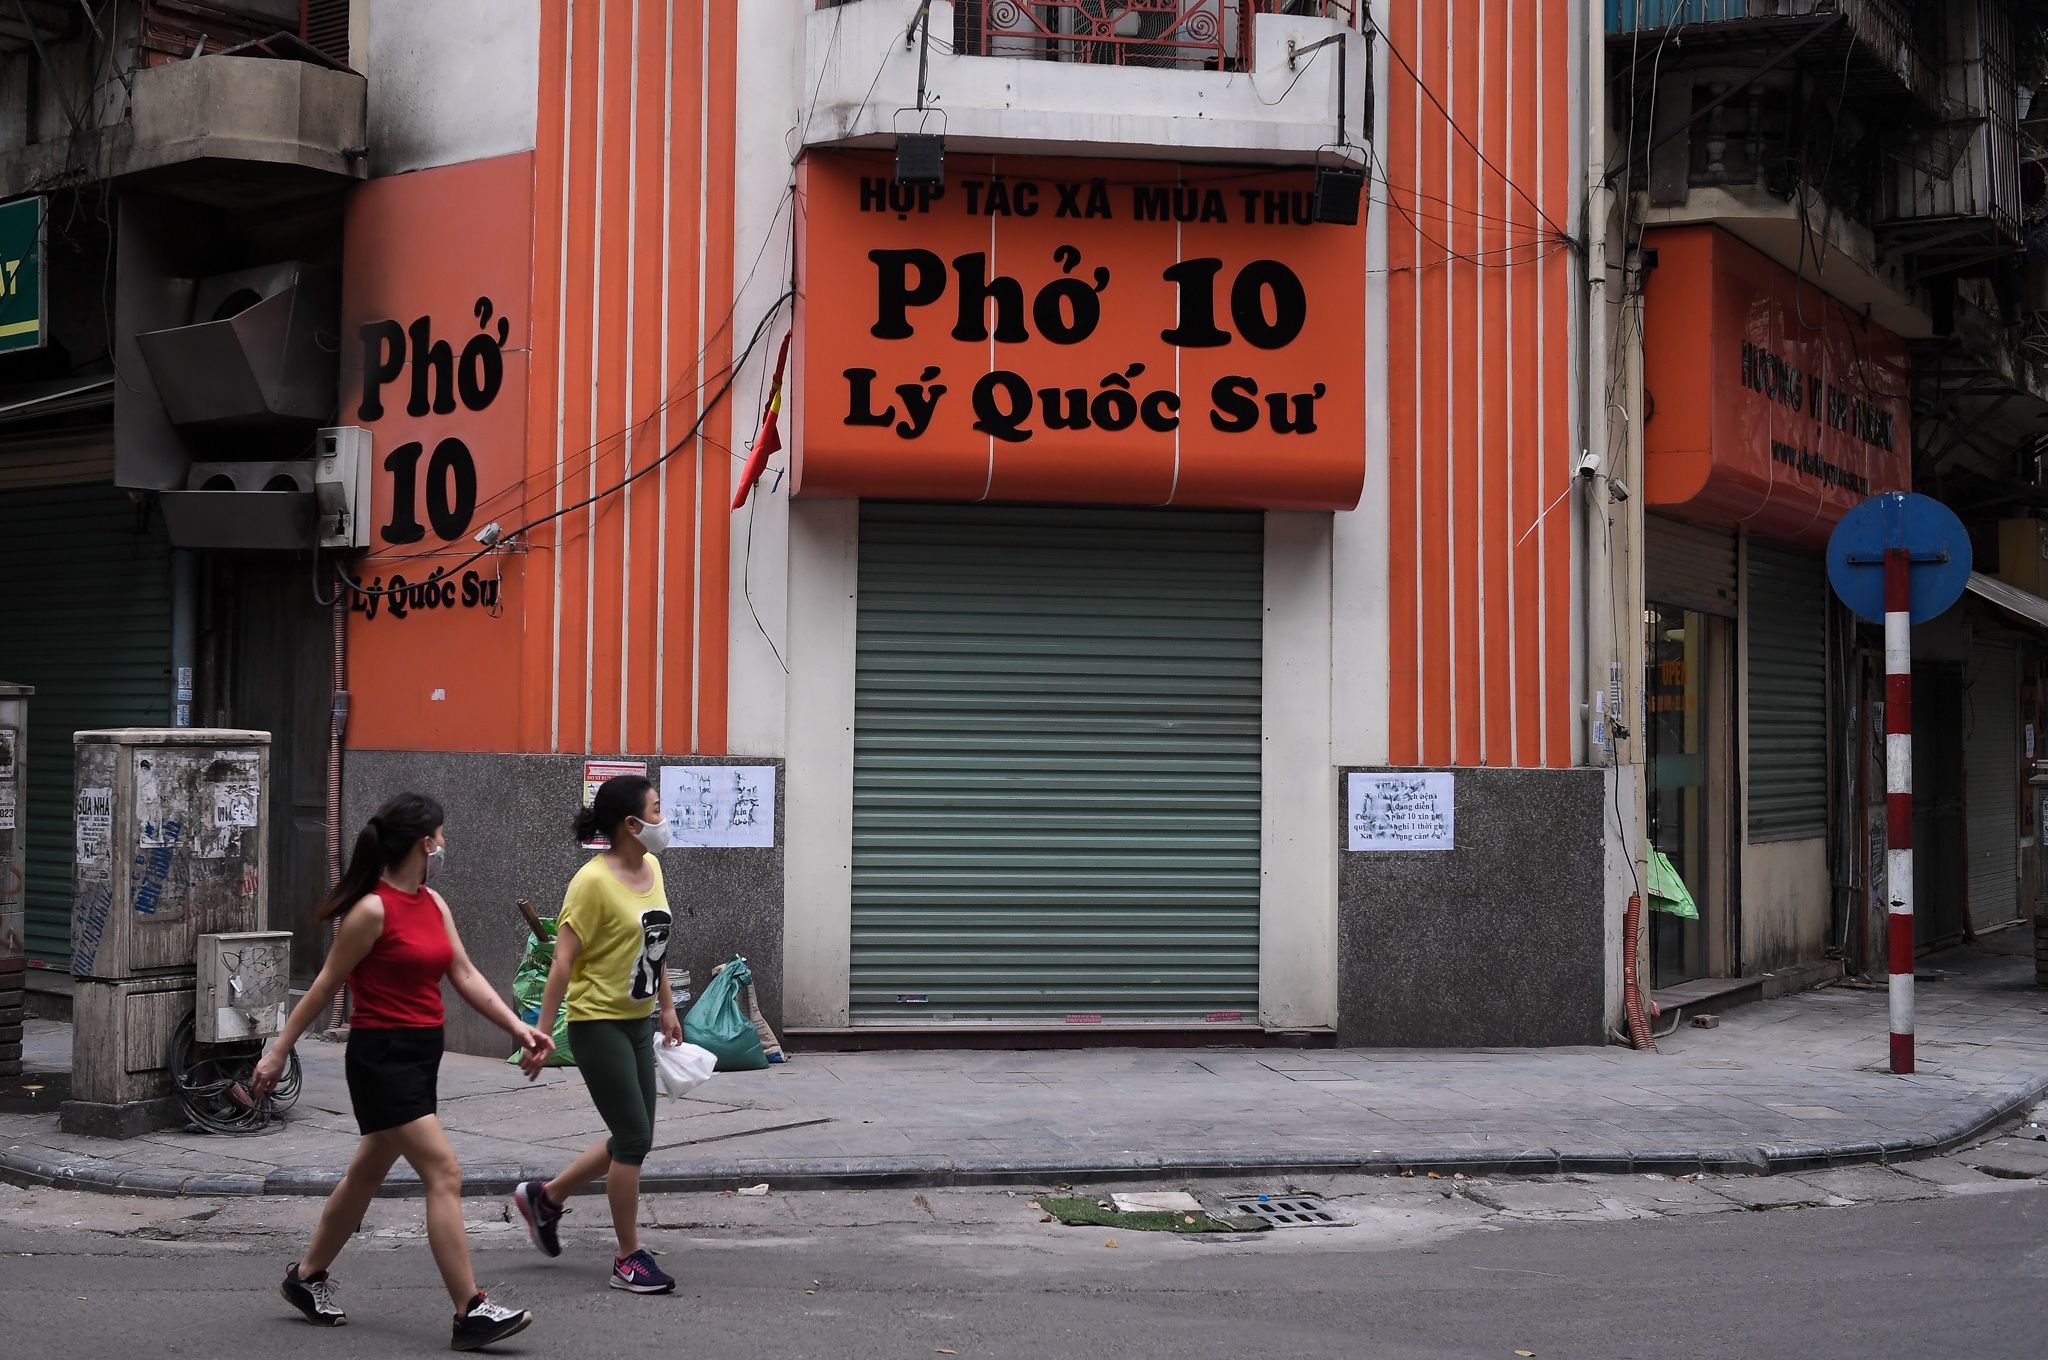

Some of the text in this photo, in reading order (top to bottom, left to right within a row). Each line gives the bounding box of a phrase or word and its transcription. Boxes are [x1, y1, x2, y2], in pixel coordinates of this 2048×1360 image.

[961, 174, 1039, 216] TÁC
[1132, 180, 1228, 223] MÙA
[868, 245, 1307, 350] Phở 10
[357, 296, 510, 544] Phở 10
[843, 362, 1327, 442] Lý Quốc Sư
[351, 576, 383, 620] Lý
[388, 566, 456, 619] Quốc
